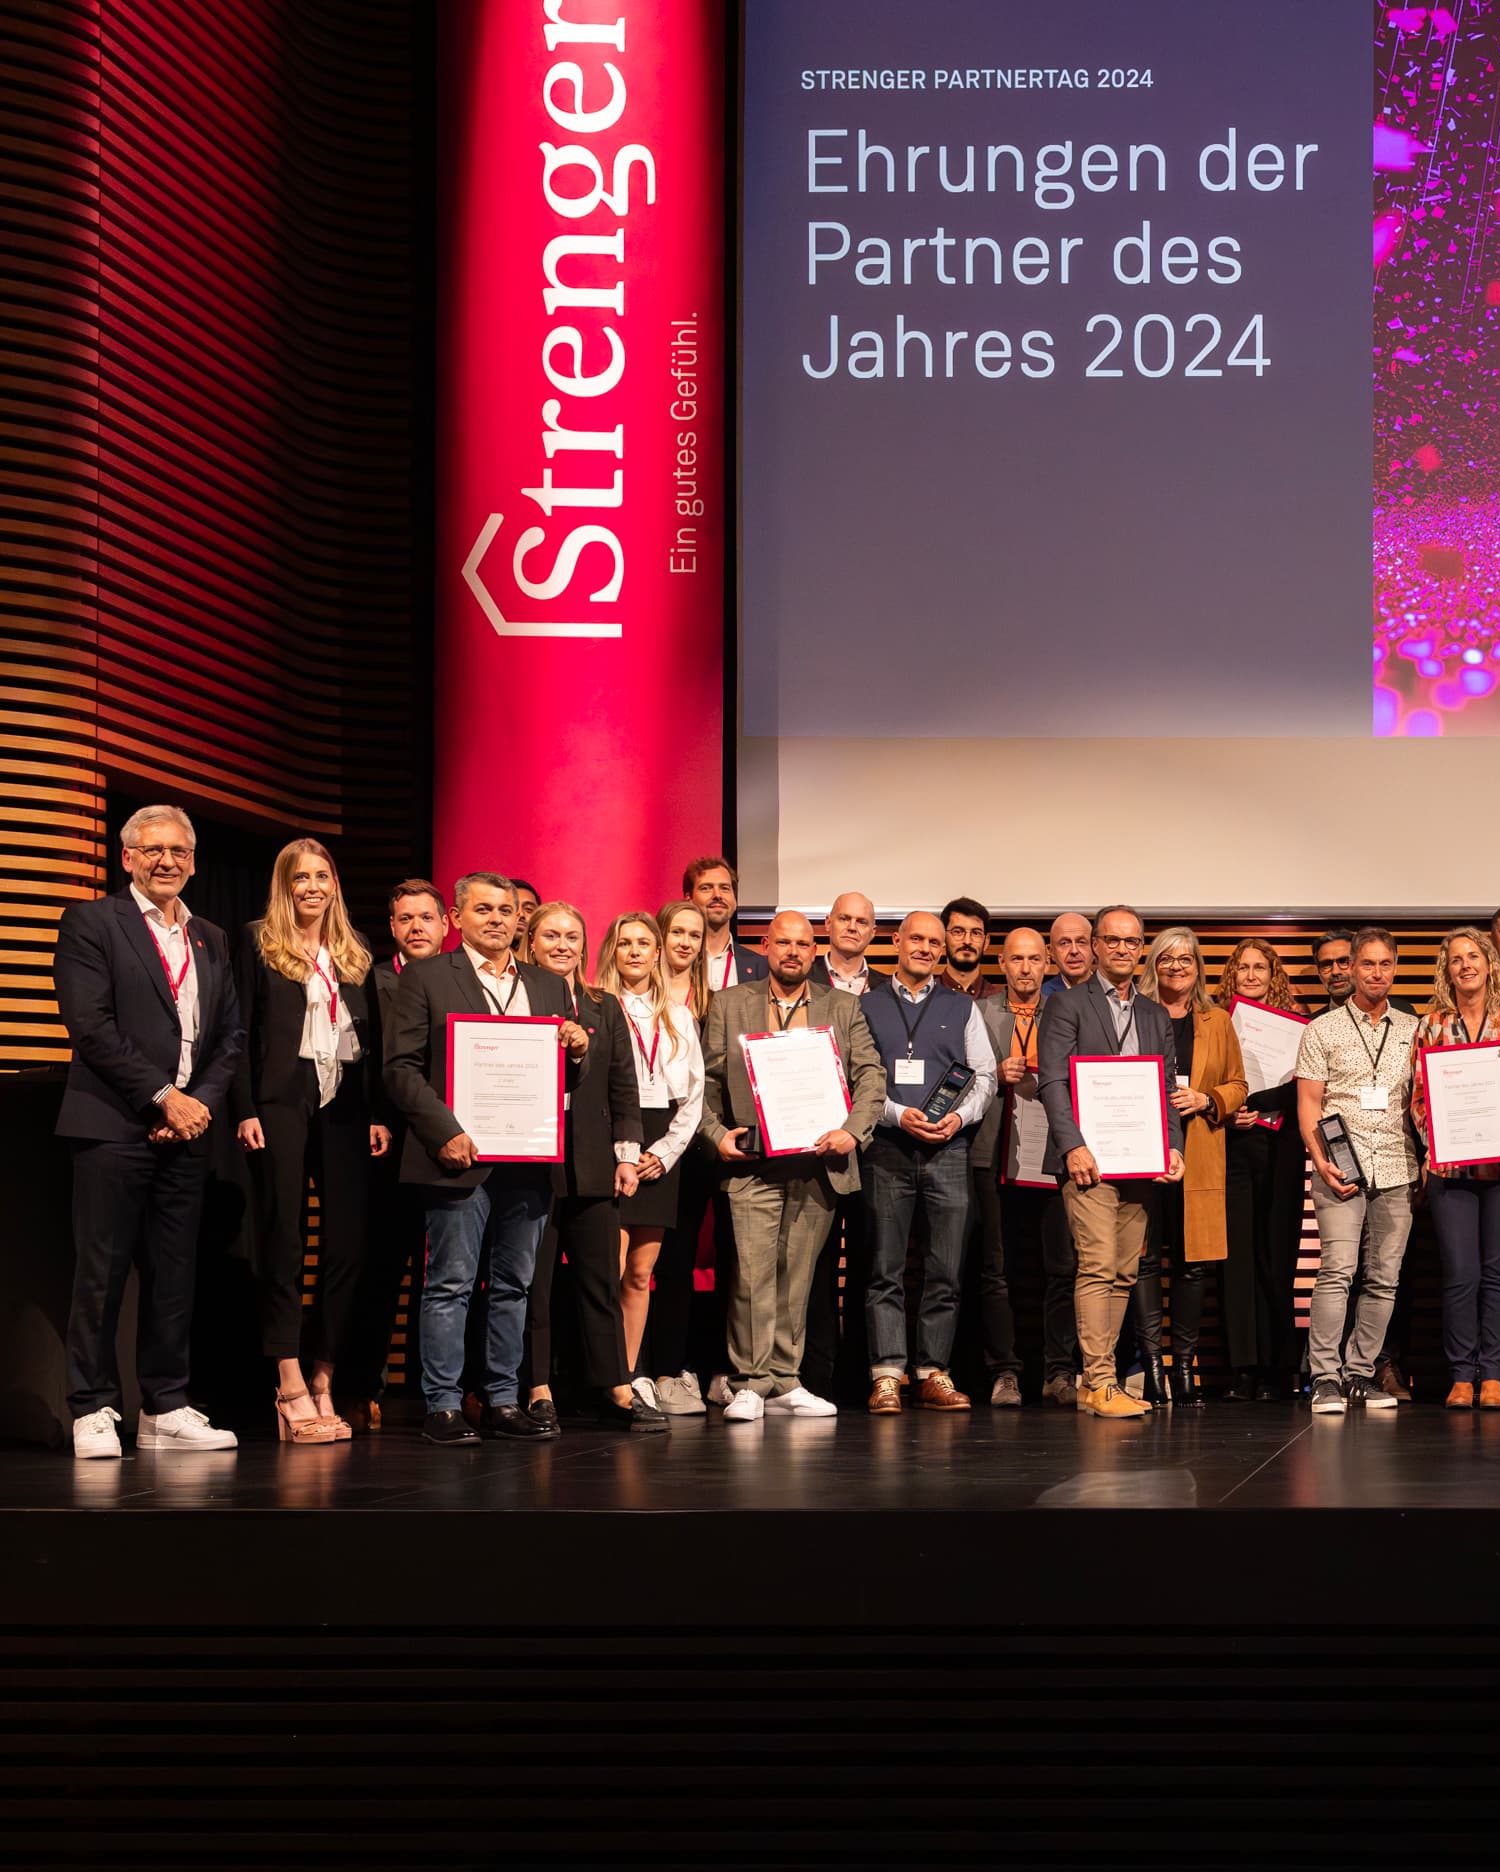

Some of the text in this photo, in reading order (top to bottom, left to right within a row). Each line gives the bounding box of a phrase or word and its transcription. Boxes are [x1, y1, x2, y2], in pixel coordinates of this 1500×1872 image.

[802, 69, 1153, 89] STRENGER PARTNERTAG 2024
[809, 128, 1318, 209] Ehrungen der
[809, 221, 1241, 285] Partner des
[514, 0, 655, 602] Strenger
[803, 314, 1271, 378] Jahres 2024
[670, 313, 703, 572] Ein gutes Gefühl.
